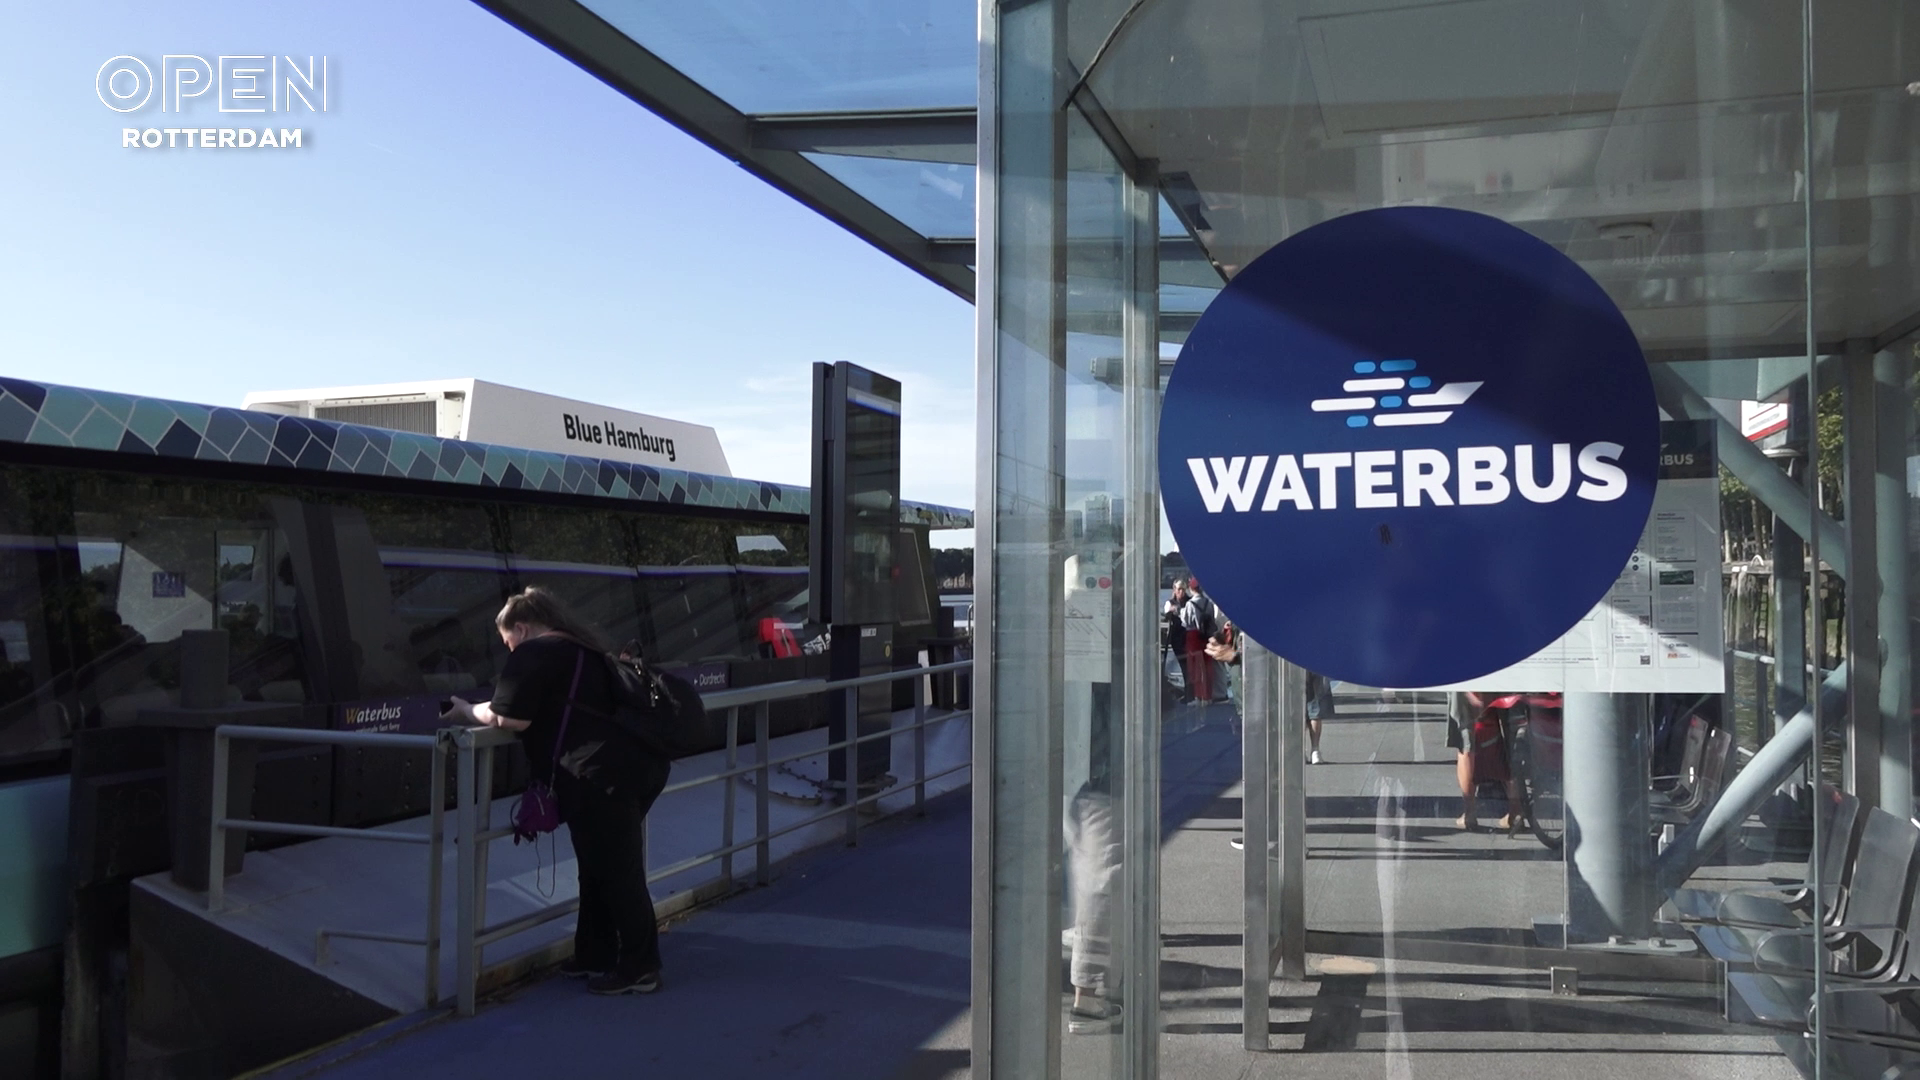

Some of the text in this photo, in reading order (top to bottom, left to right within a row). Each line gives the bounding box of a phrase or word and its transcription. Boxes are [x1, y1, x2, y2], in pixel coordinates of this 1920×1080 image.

[563, 413, 676, 462] Blue Hamburg
[1187, 441, 1628, 513] WATERBUS
[699, 671, 726, 687] Dordrecht
[346, 702, 401, 723] Waterbus
